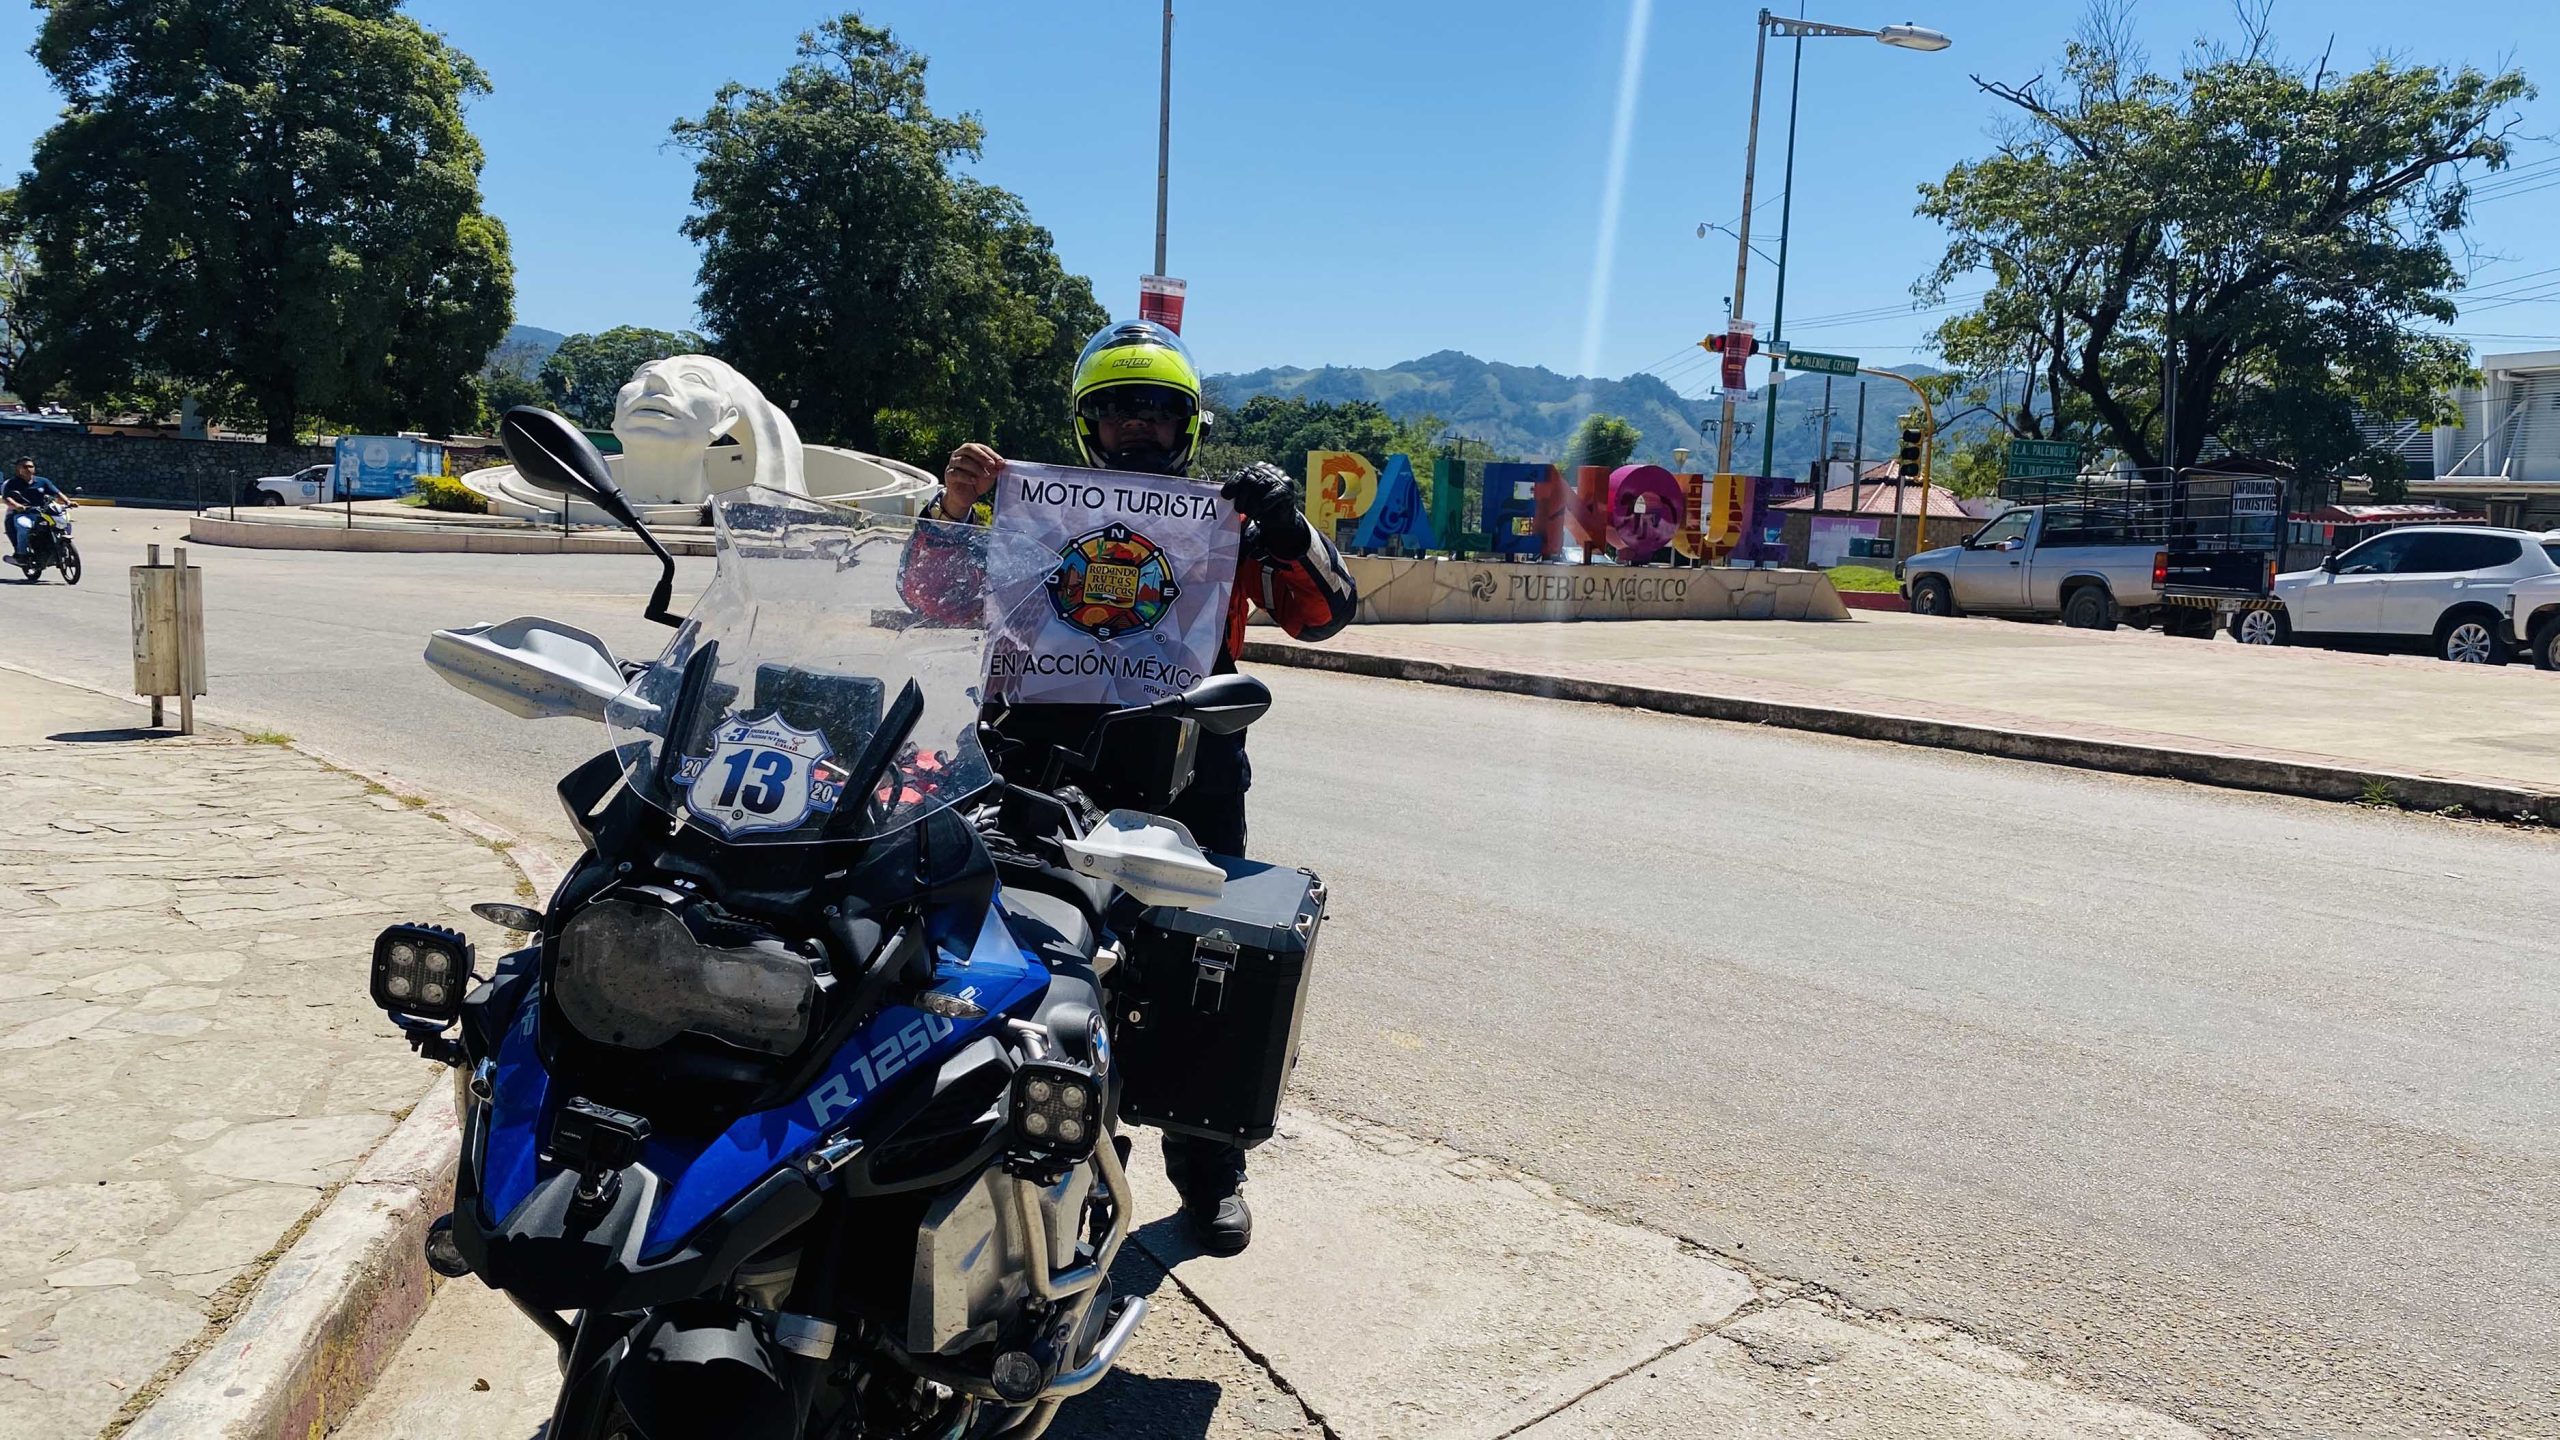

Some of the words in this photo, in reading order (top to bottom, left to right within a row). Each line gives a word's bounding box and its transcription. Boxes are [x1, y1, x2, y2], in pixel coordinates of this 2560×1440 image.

[1801, 356, 1832, 370] PALENQUE
[1833, 360, 1856, 373] CENTRO
[2032, 444, 2068, 457] PALENQUE
[2235, 480, 2284, 495] INFORMACI
[1020, 479, 1105, 510] MOTO
[1114, 488, 1219, 521] TURISTA
[1306, 449, 1796, 566] PALENQUE
[2234, 497, 2277, 511] TURISTIC
[1110, 528, 1125, 539] N
[1163, 587, 1175, 597] E
[1098, 627, 1111, 637] S
[990, 655, 1016, 677] EN
[1021, 648, 1118, 676] ACCIÓN
[681, 760, 703, 779] 20
[717, 748, 794, 815] 13
[809, 782, 834, 804] 20
[807, 1073, 854, 1127] R
[850, 1013, 955, 1092] 1250
